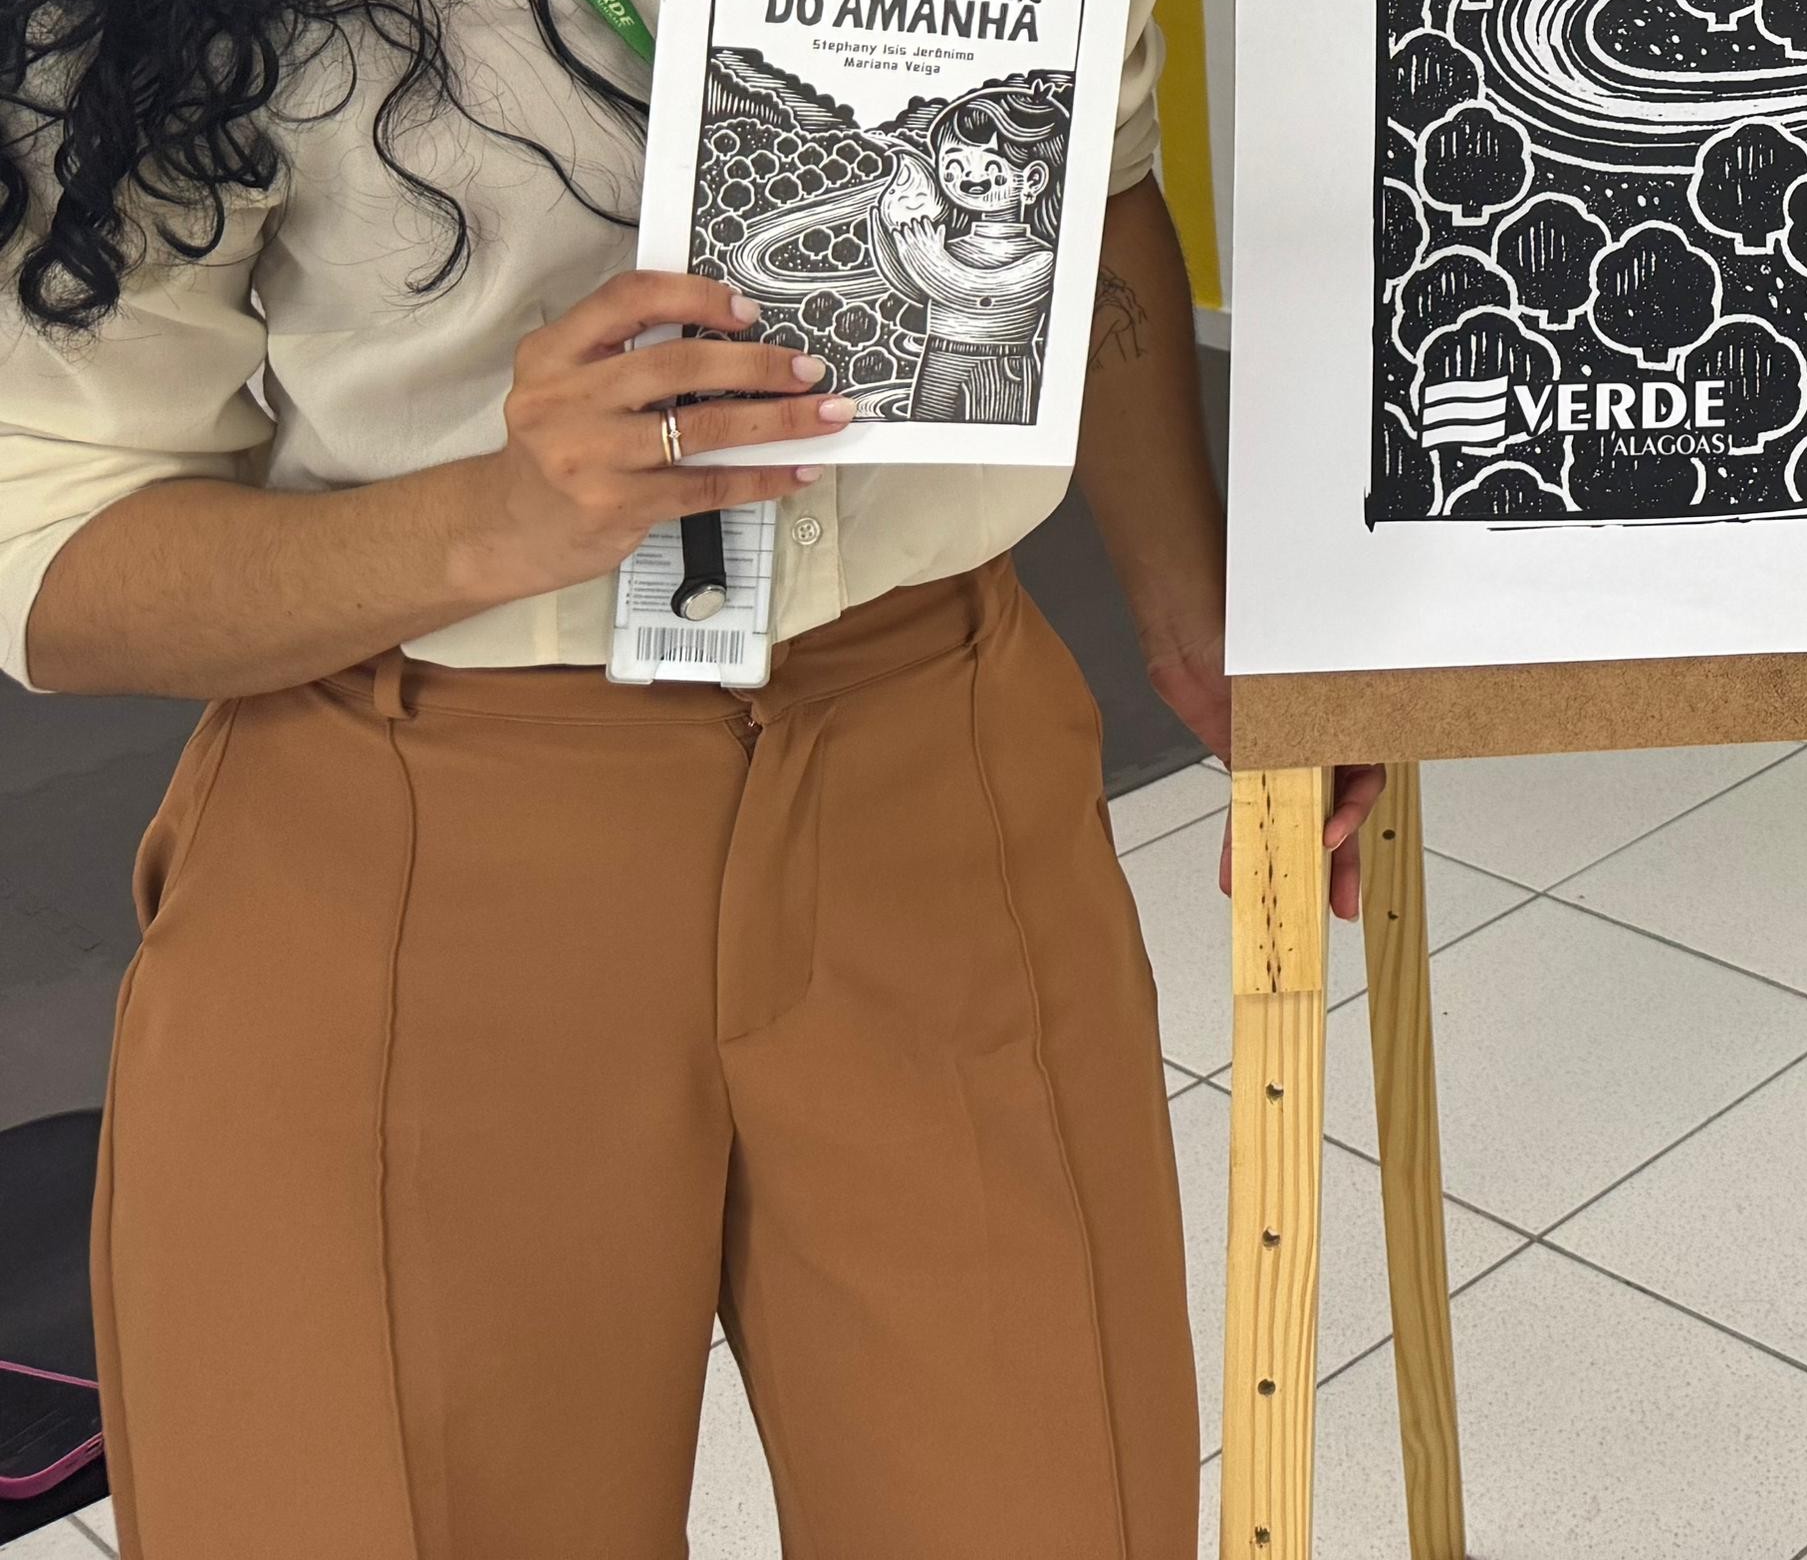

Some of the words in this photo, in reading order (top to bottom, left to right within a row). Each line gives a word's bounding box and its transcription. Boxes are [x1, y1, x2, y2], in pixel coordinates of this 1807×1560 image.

[814, 40, 876, 55] Stephany
[884, 45, 905, 55] Isis
[914, 48, 973, 60] Jerônimo
[844, 58, 897, 70] Mariana
[906, 62, 940, 75] Veiga
[1514, 380, 1725, 433] VERDE
[1613, 433, 1725, 457] ALAGOAS
